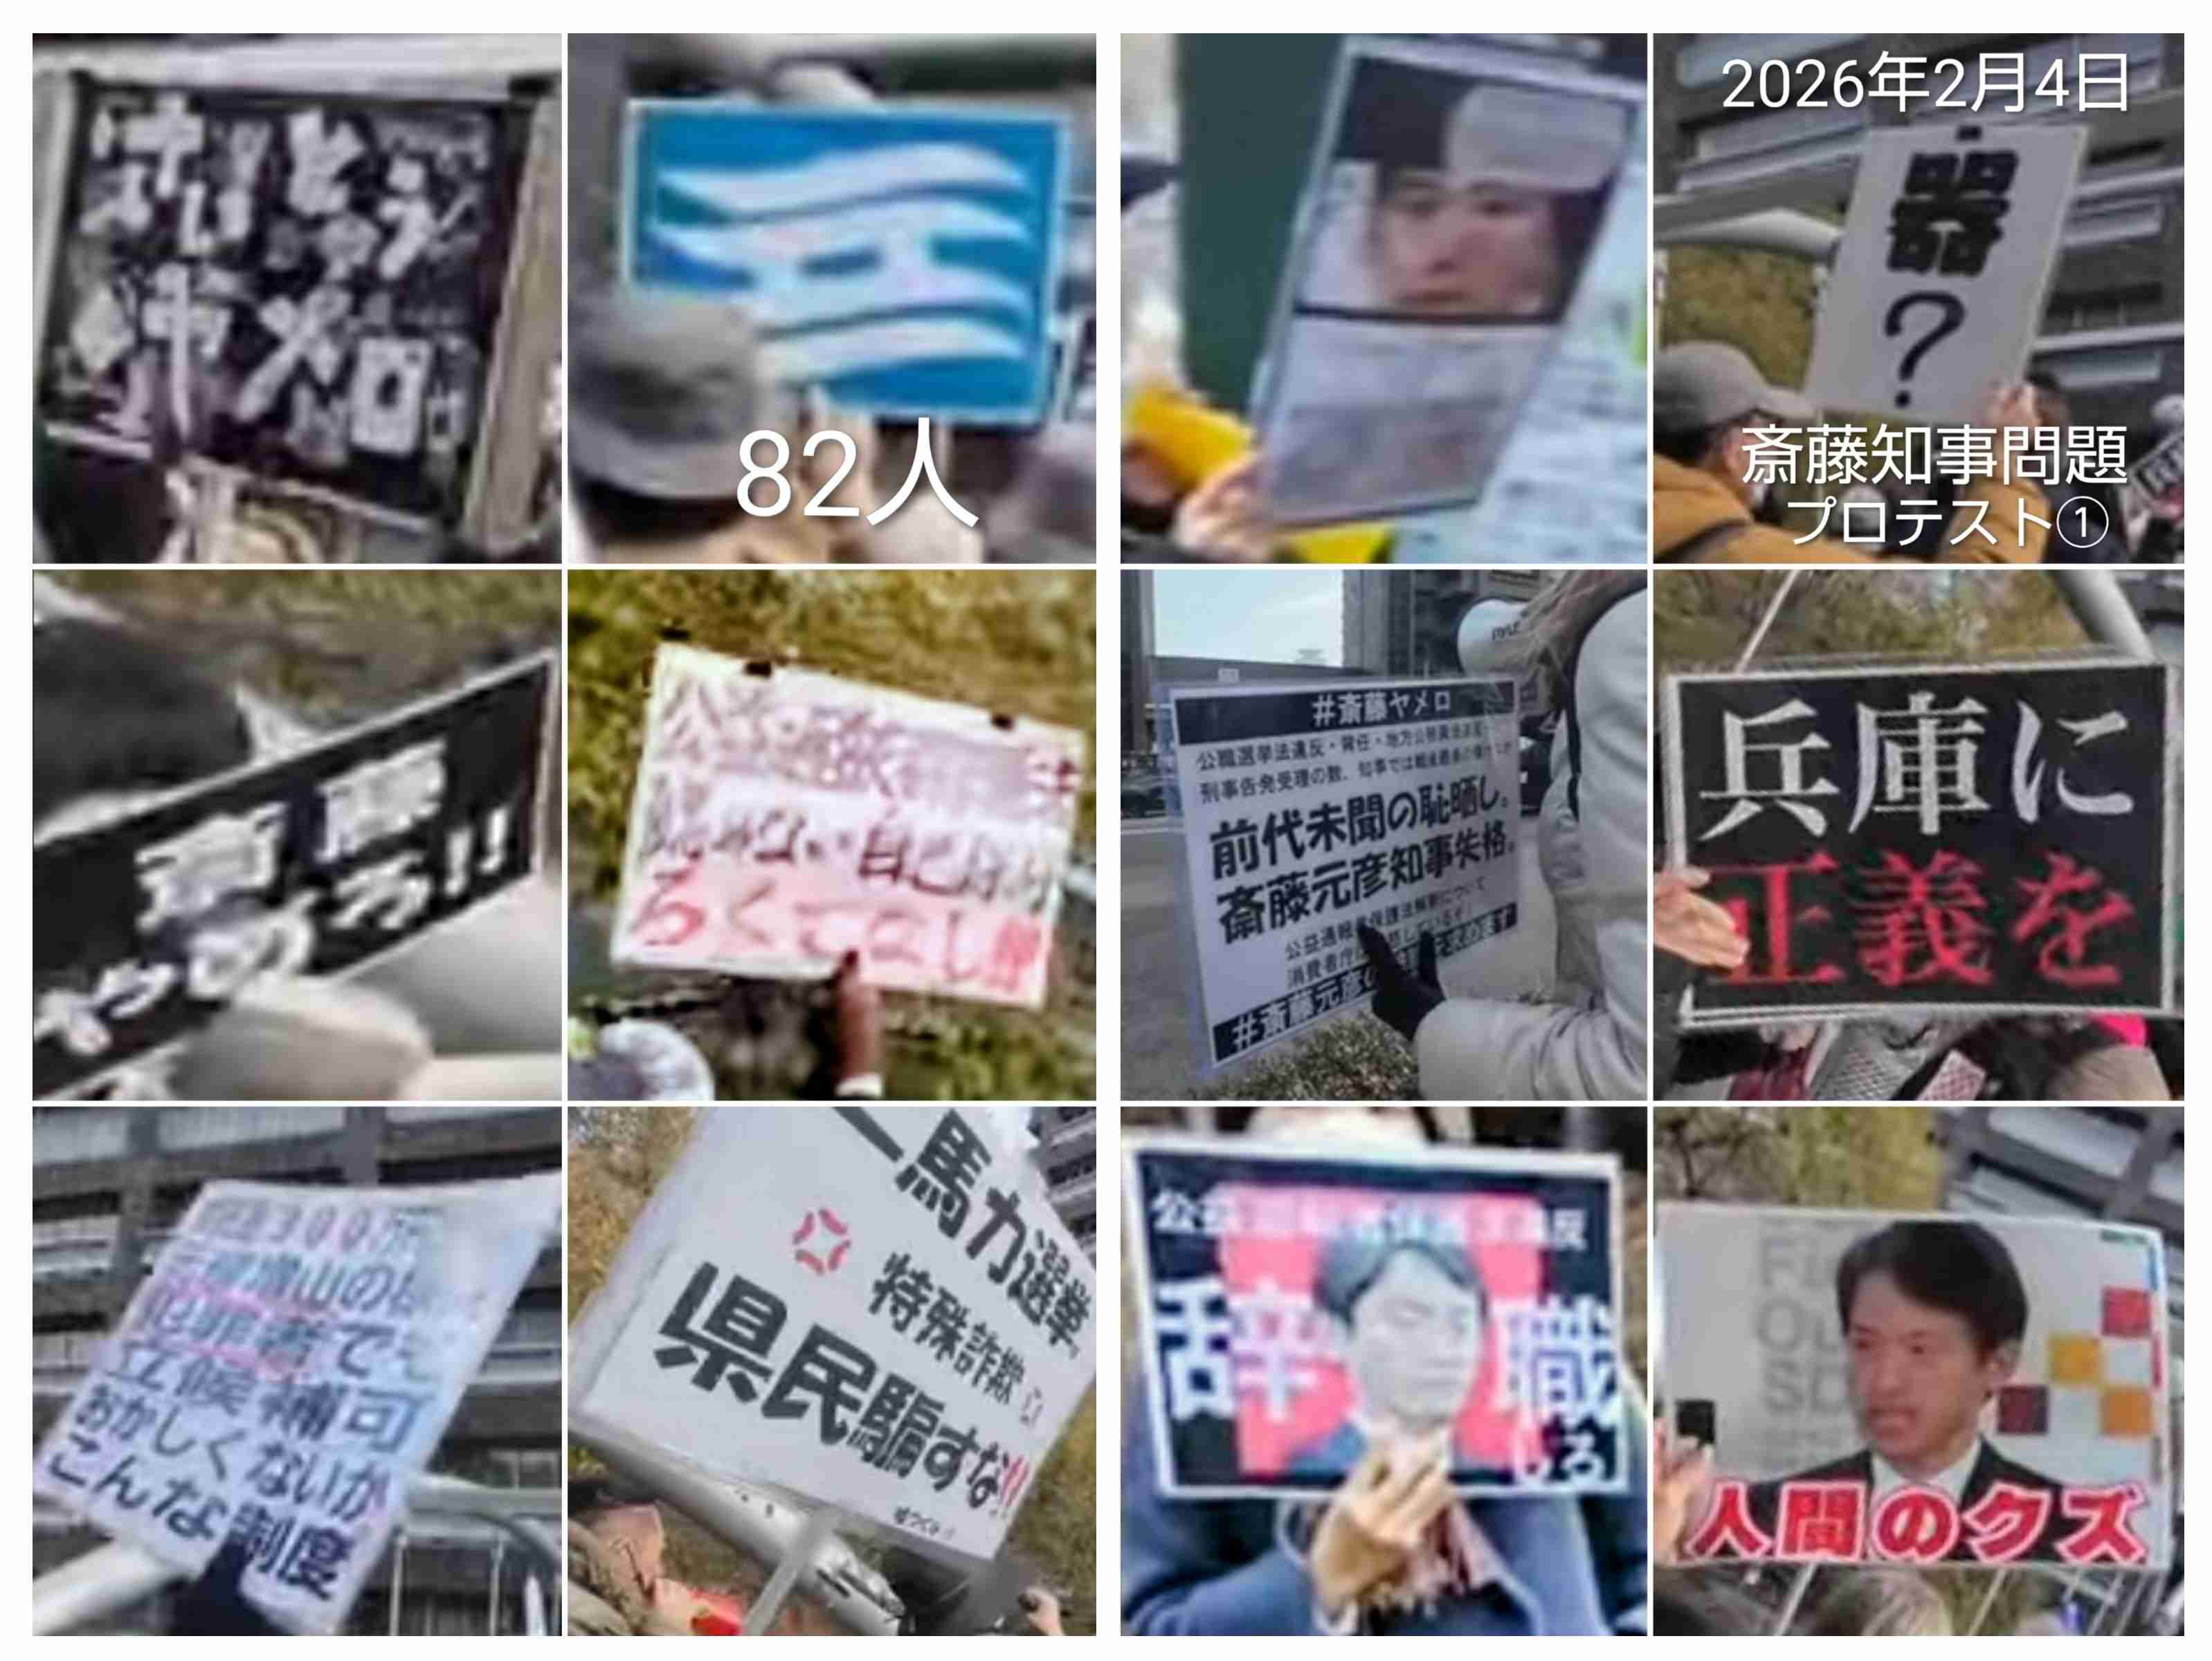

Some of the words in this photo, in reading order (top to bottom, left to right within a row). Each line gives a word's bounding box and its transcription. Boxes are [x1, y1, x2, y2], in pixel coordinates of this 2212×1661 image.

[1209, 775, 1510, 881] 前代未聞の恥晒し。
[1698, 690, 2135, 842] 兵庫に
[1216, 822, 1516, 944] 斎藤元彦知事失格。
[1693, 848, 2135, 988] 正義を
[867, 1251, 1026, 1406] 特殊詐欺
[46, 1433, 354, 1601] こんな制度
[1686, 1480, 2148, 1564] 人間のクズ
